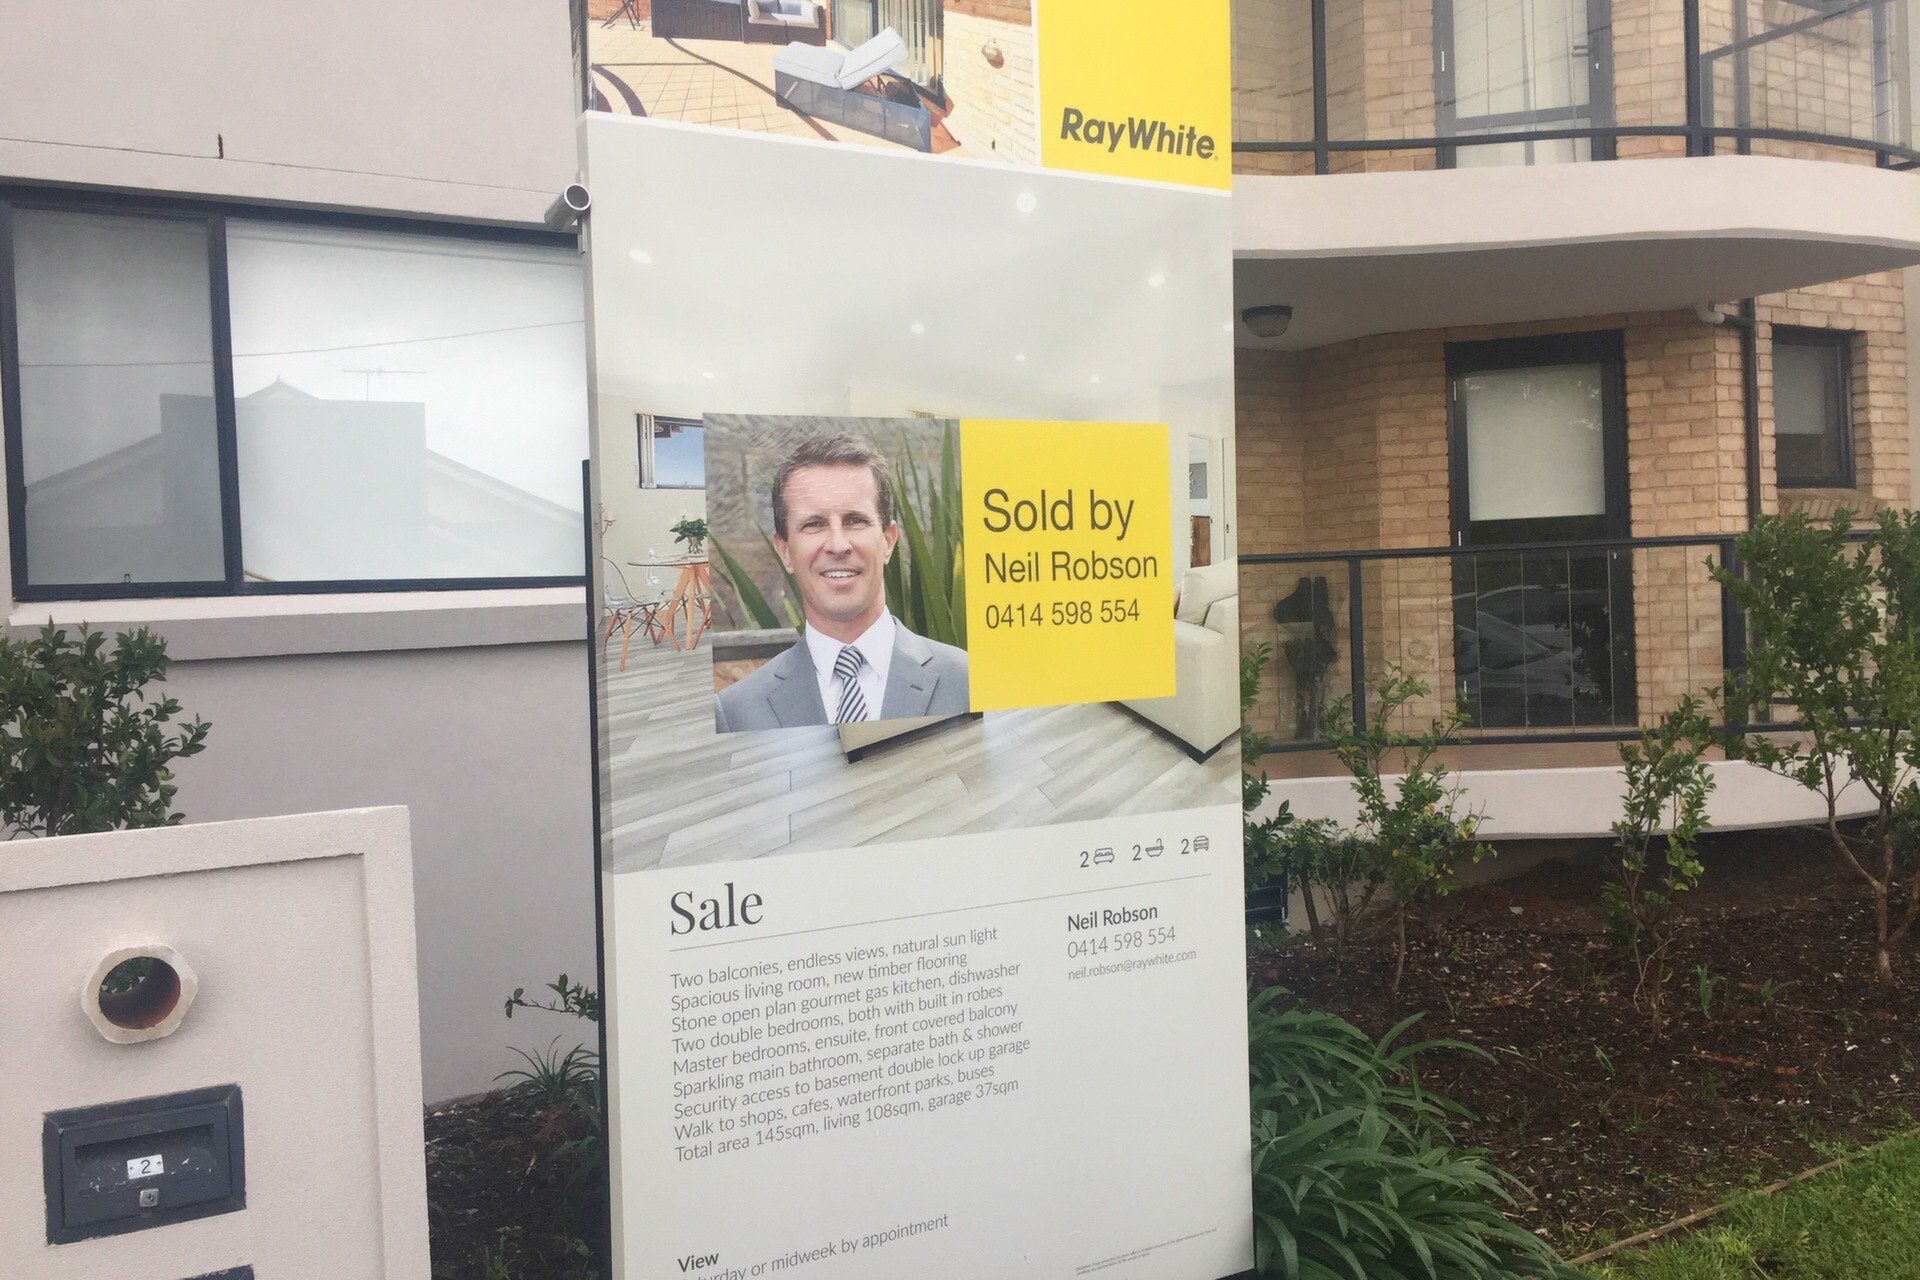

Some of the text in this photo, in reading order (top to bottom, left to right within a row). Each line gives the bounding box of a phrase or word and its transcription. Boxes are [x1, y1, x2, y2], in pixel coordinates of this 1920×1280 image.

[983, 488, 1135, 541] Sold by
[985, 550, 1158, 584] Neil Robson
[986, 598, 1140, 629] 0414 598 554
[1080, 838, 1190, 868] 2 2 2
[670, 882, 763, 935] Sale
[1067, 906, 1158, 932] Neil Robson
[671, 927, 998, 989] Two balconies, endless views, natural sun light
[1067, 925, 1176, 958] 0414 598 554
[1068, 949, 1197, 981] neil.robson@raywhite.com
[671, 952, 968, 1012] Spacious living room, new timber flooring
[671, 962, 1021, 1033] Stone open plan gourmet gas kitchen, dishwasher
[672, 986, 1003, 1054] Two double bedrooms, both with built in robes
[673, 1002, 1018, 1076] Master bedrooms, ensuite, front covered balcony
[673, 1020, 1024, 1099] Sparkling main bathroom, separate bath & shower
[674, 1039, 1031, 1120] Security access to basement double lock up garage
[674, 1065, 995, 1141] Walk to shops, cafes, waterfront parks, buses
[675, 1080, 1019, 1162] Total area 145sqm, living 108sqm, garage 37sqm
[140, 1159, 151, 1174] 2
[678, 1252, 719, 1273] View
[750, 1262, 767, 1276] or
[771, 1242, 837, 1271] midweek
[841, 1238, 858, 1253] by
[862, 1214, 950, 1249] appointment
